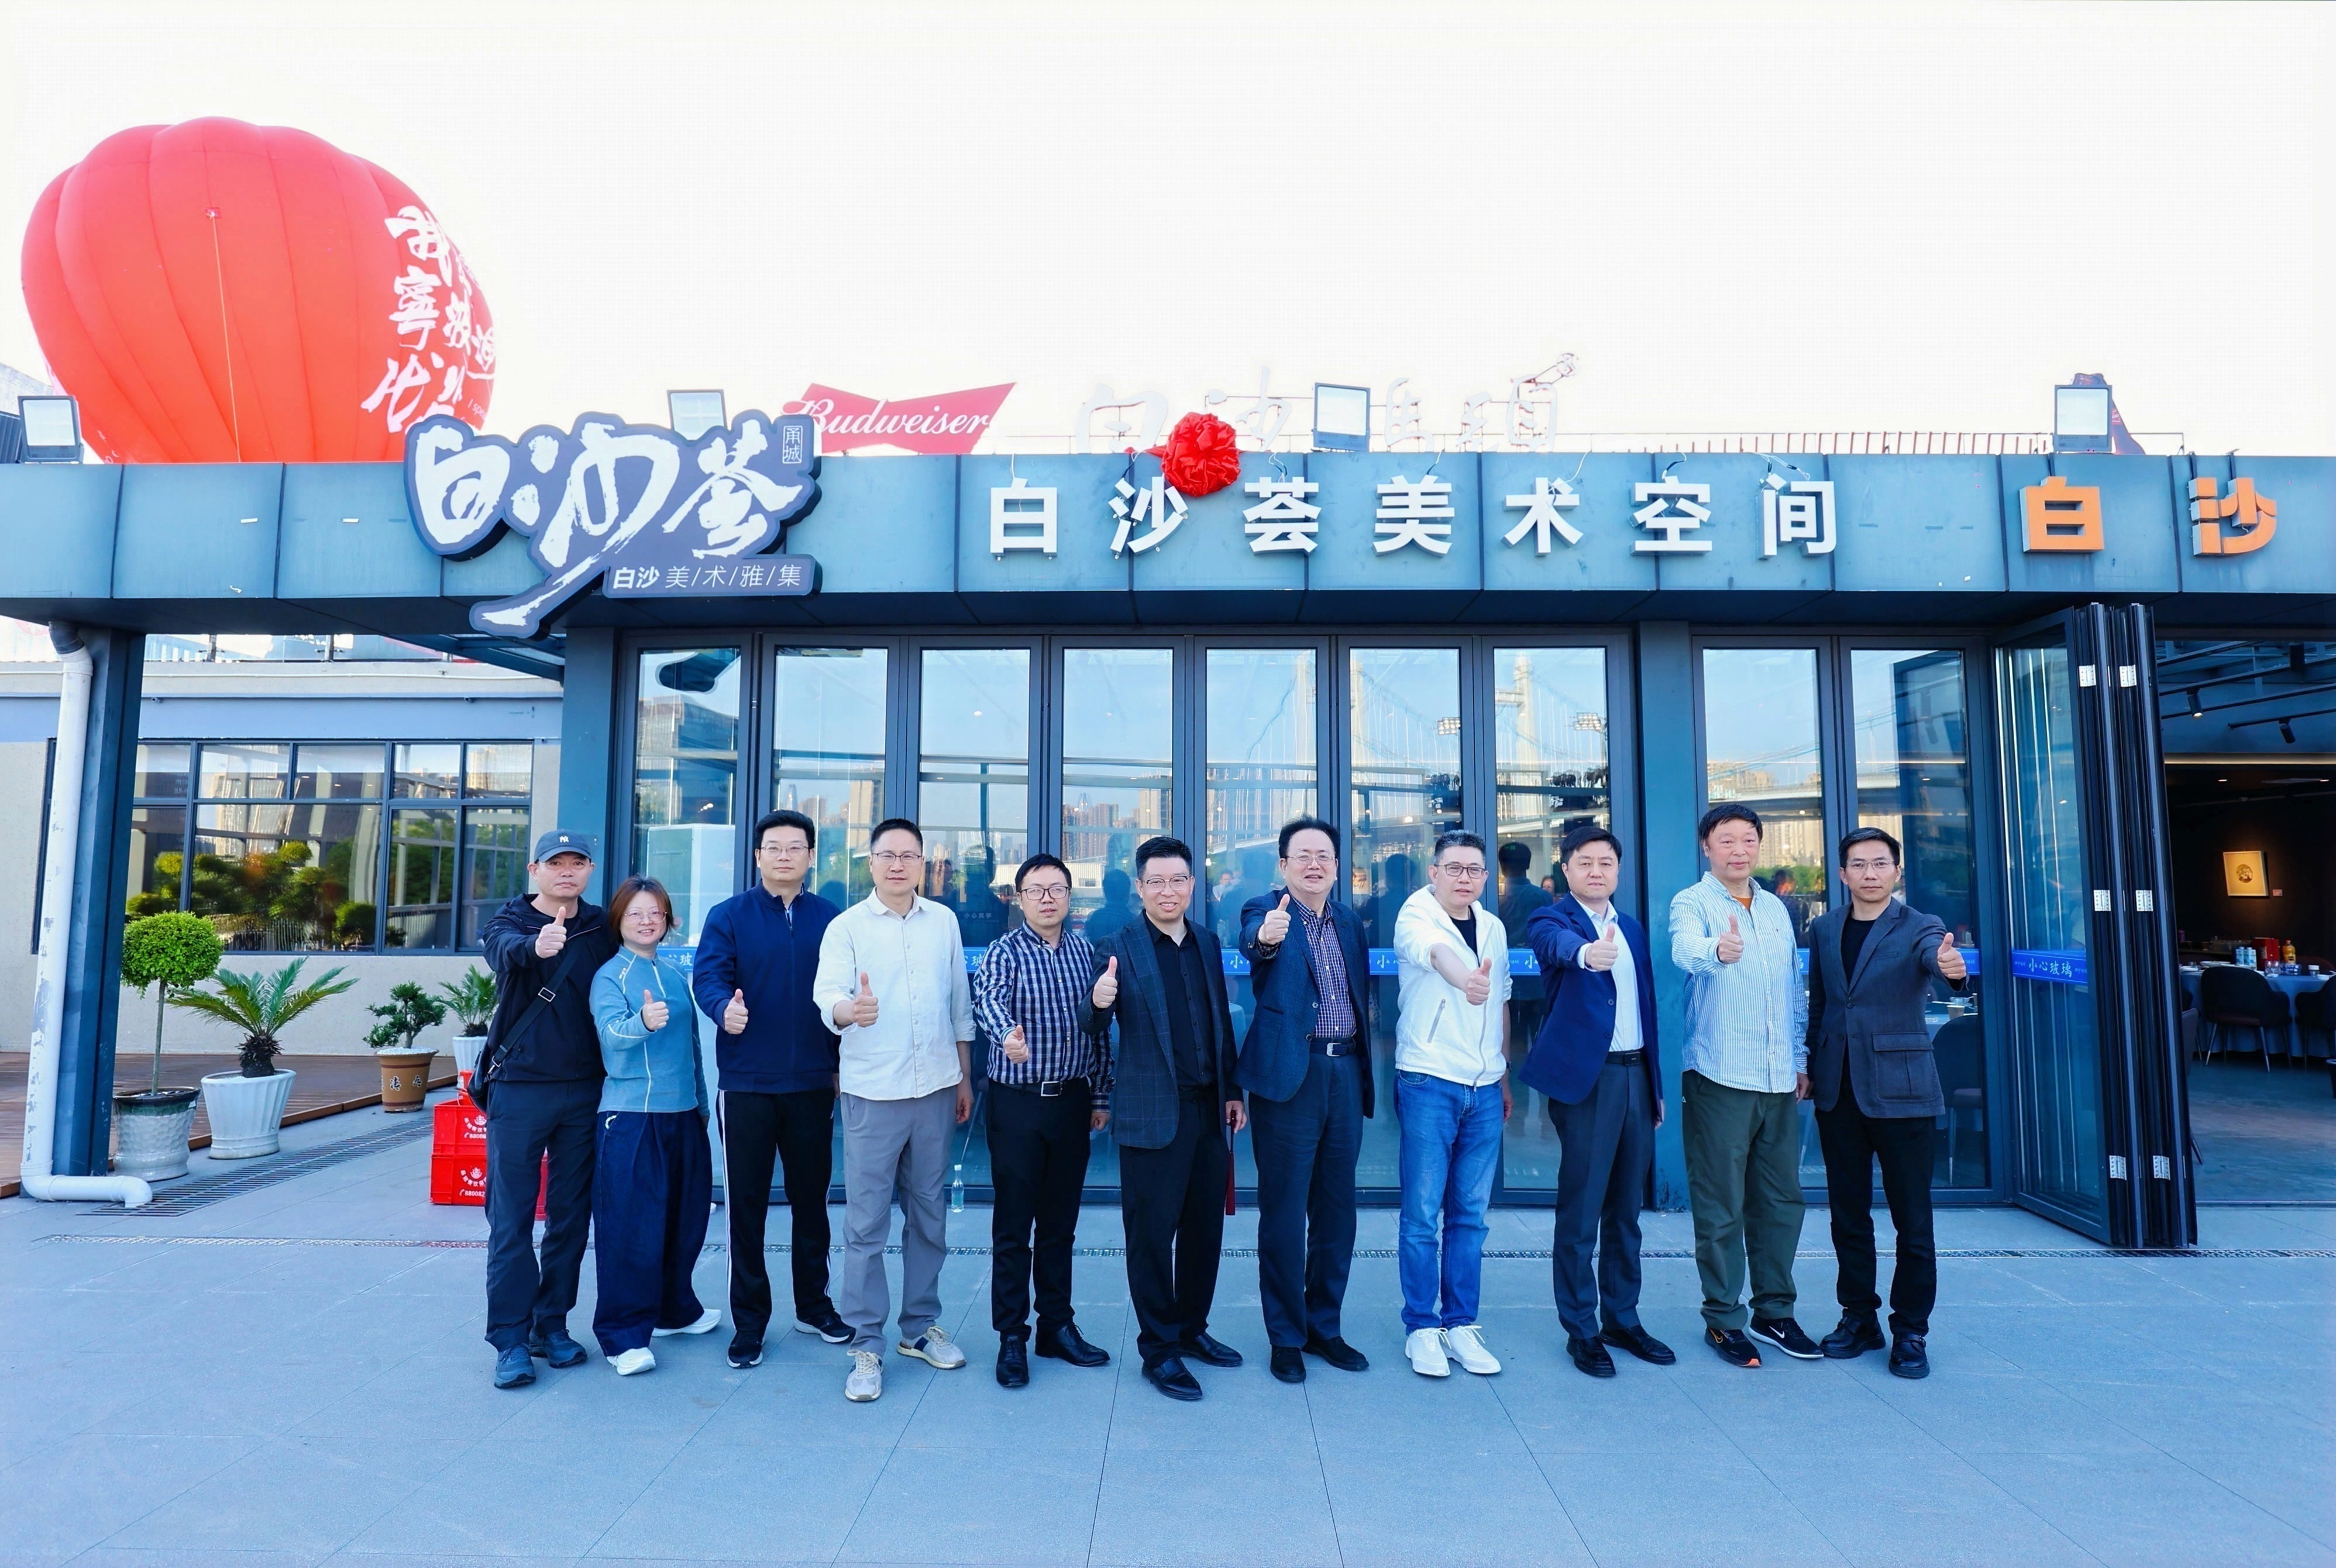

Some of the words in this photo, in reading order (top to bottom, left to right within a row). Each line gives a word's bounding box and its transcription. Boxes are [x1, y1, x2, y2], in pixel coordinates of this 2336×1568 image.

[780, 398, 989, 435] Budweiser
[783, 427, 801, 463] 甬城
[990, 473, 1837, 560] 白沙荟美术空间
[2020, 475, 2277, 557] 白沙
[2028, 957, 2072, 978] 小心玻璃
